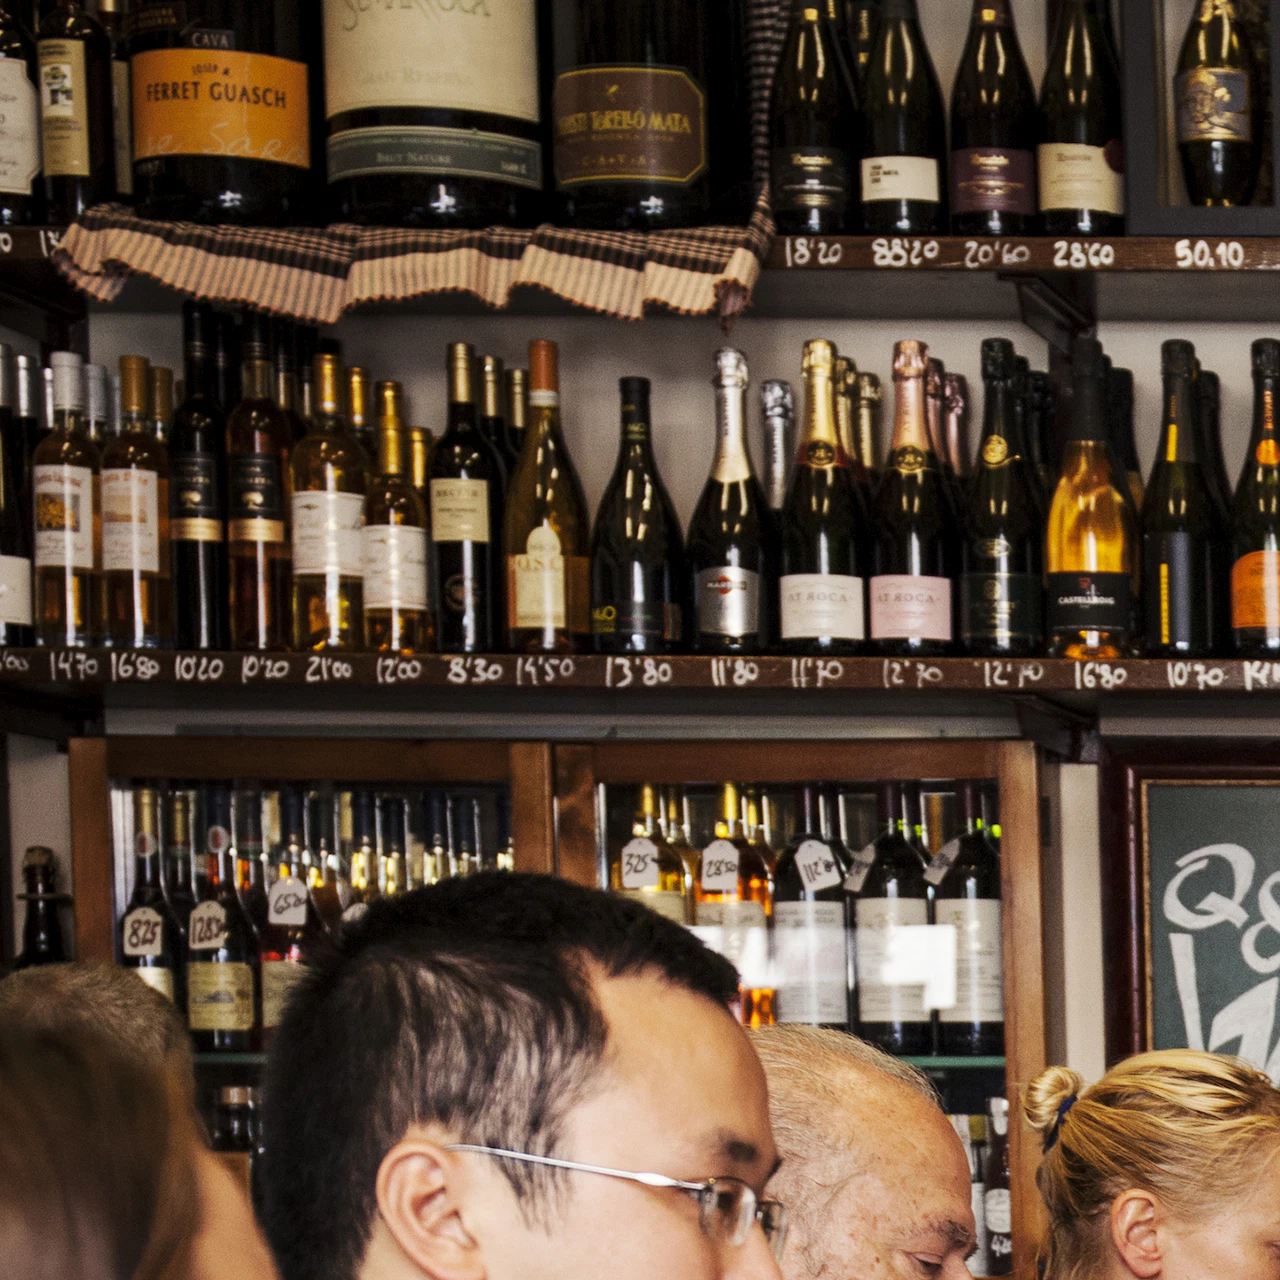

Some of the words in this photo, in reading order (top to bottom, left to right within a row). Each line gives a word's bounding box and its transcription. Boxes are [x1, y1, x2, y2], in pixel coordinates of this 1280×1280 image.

[192, 32, 229, 48] CAVA
[147, 82, 200, 101] FERRET
[209, 82, 286, 108] GUASCH
[648, 113, 693, 135] MATA
[785, 237, 842, 267] 18'20
[872, 237, 940, 267] 88'20
[965, 239, 1031, 269] 20'60
[111, 652, 160, 682] 16'80
[175, 655, 223, 681] 10'20
[305, 656, 353, 684] 21'00
[376, 656, 422, 684] 12'00
[447, 657, 503, 684] 8'30
[605, 656, 672, 688] 13'80
[711, 657, 759, 687] 11'80
[1075, 661, 1128, 690] 16'80
